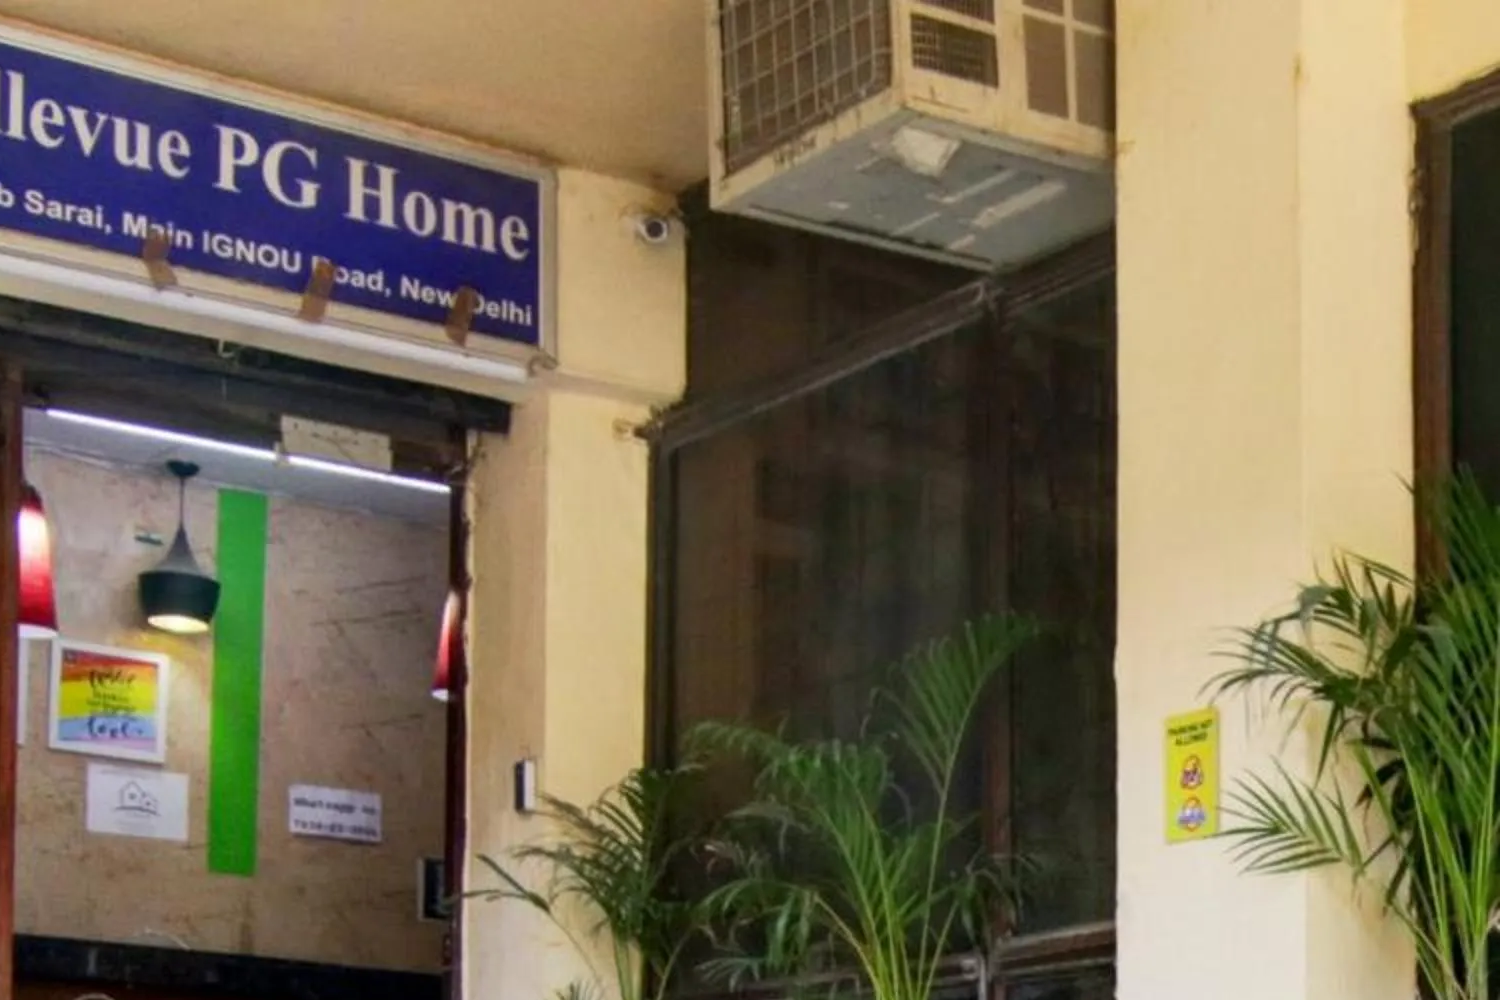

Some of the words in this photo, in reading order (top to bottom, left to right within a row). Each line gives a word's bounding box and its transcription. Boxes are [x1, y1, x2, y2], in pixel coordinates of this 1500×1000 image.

[23, 189, 112, 234] Sarai,
[203, 231, 301, 274] IGNOU
[400, 274, 458, 309] New
[212, 123, 320, 209] PG
[343, 156, 529, 261] Home
